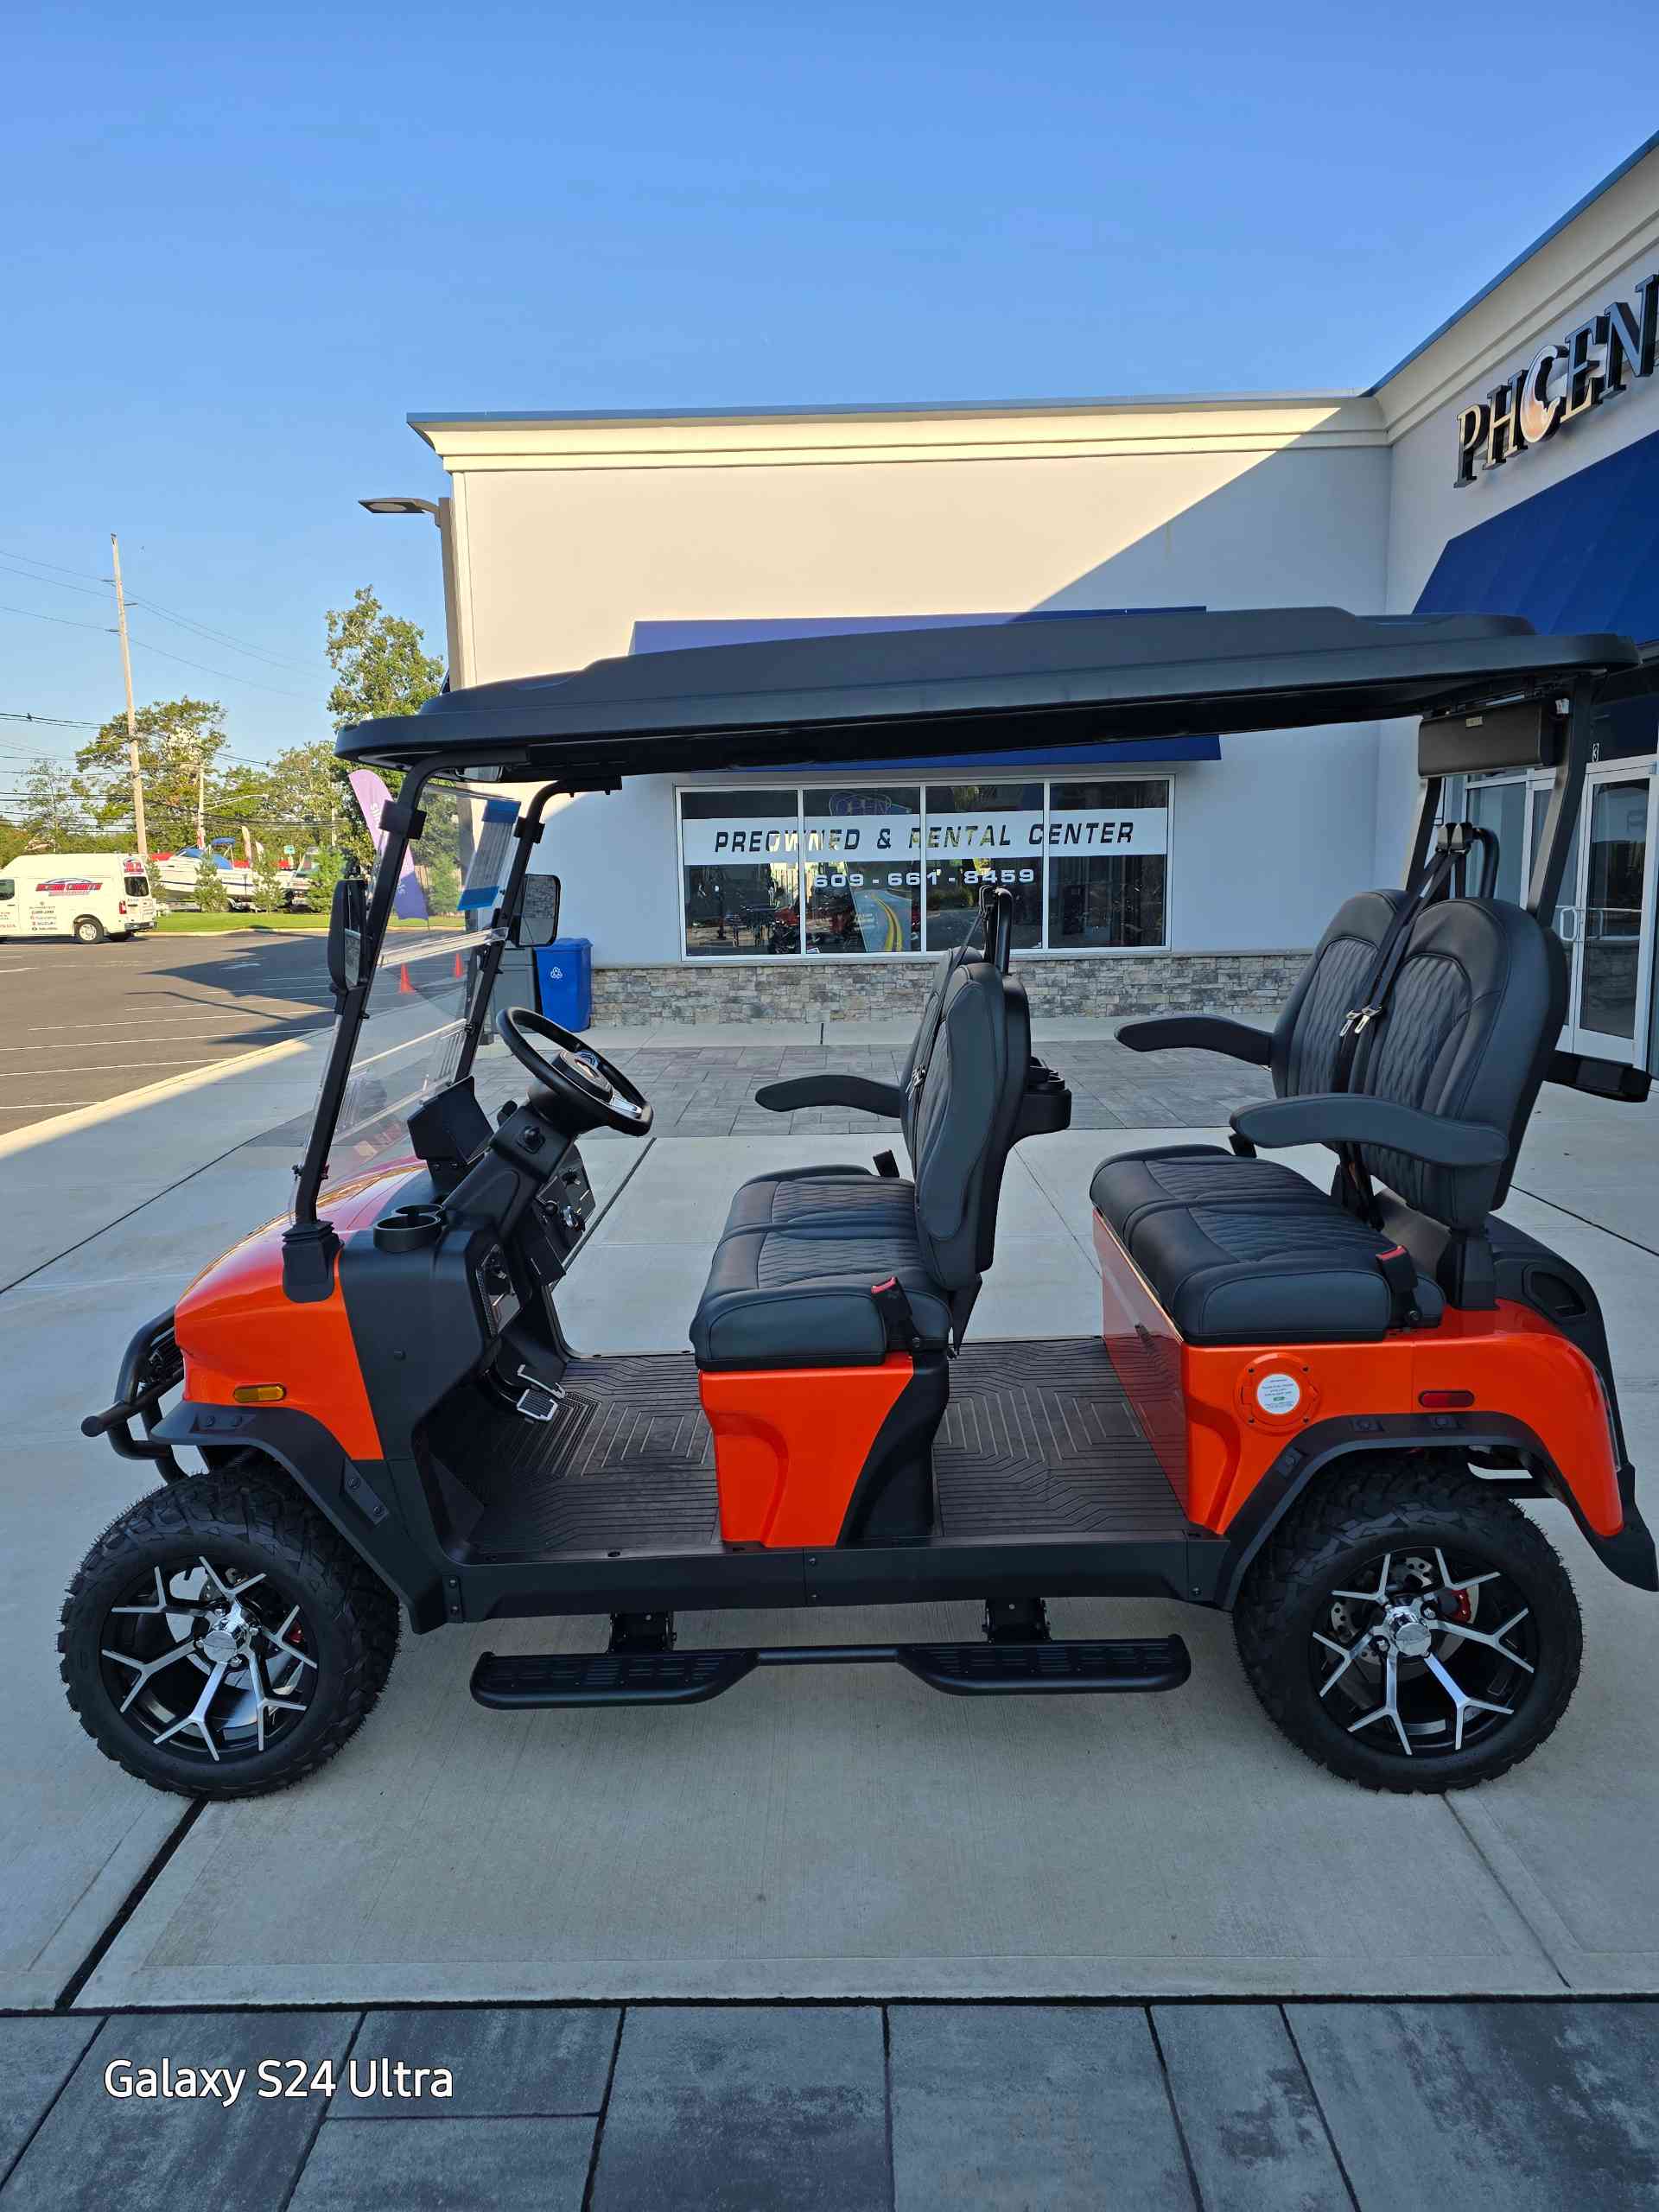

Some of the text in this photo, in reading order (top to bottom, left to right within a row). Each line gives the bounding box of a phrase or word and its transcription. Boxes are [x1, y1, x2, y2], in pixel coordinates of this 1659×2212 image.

[715, 822, 1134, 853] PREOWNED & RENTAL CENTER
